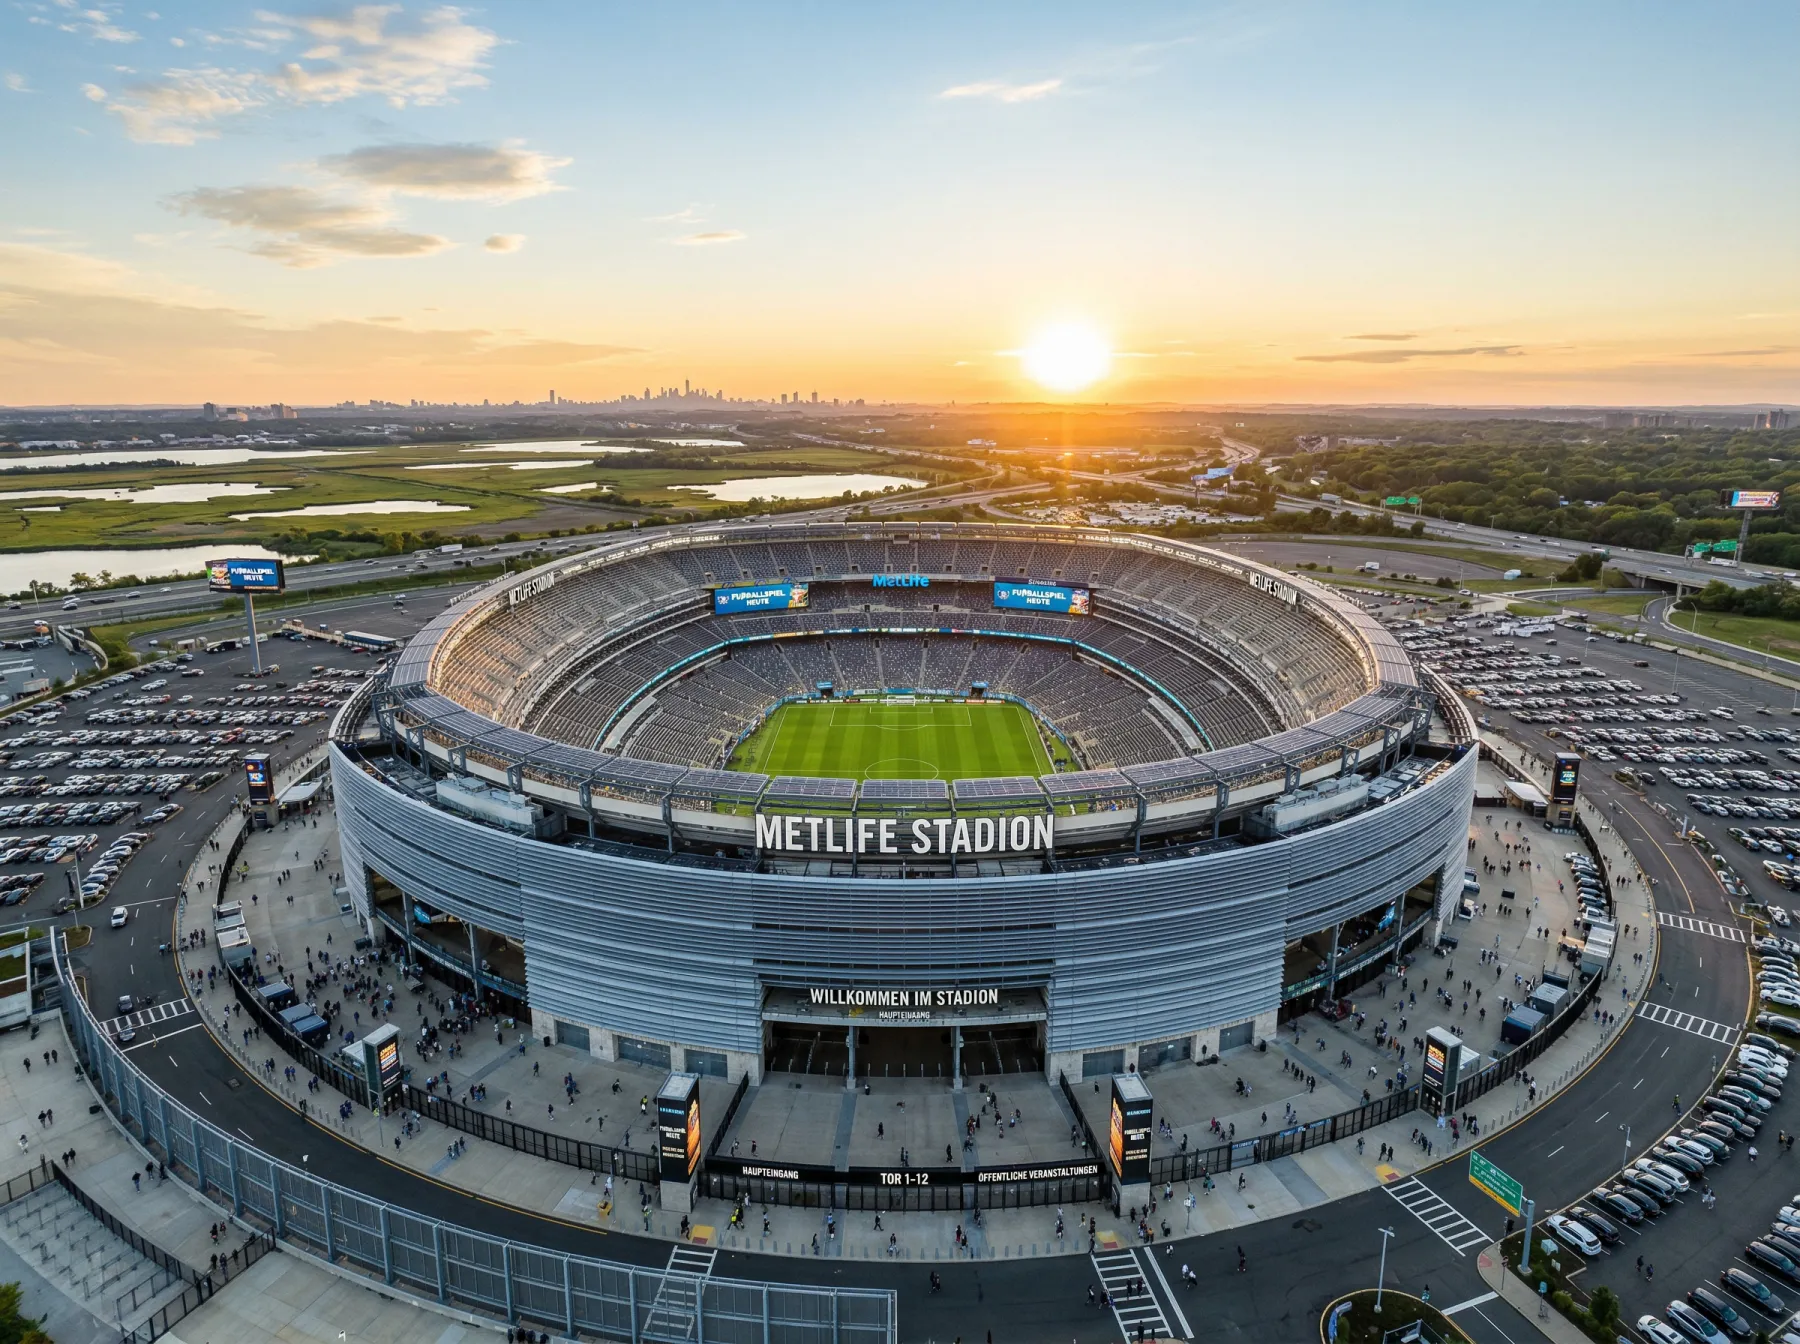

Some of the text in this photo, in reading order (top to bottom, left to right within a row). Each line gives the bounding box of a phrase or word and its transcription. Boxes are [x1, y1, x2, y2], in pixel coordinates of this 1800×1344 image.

[872, 573, 930, 588] MetLife
[755, 813, 1054, 855] METLIFE STADION
[810, 987, 998, 1007] WILLKOMMEN IM STADION
[742, 1166, 799, 1180] HAUPTEINGANG
[880, 1172, 929, 1185] TOR 1-12
[1028, 1164, 1098, 1179] VERANSTALTUNGEN
